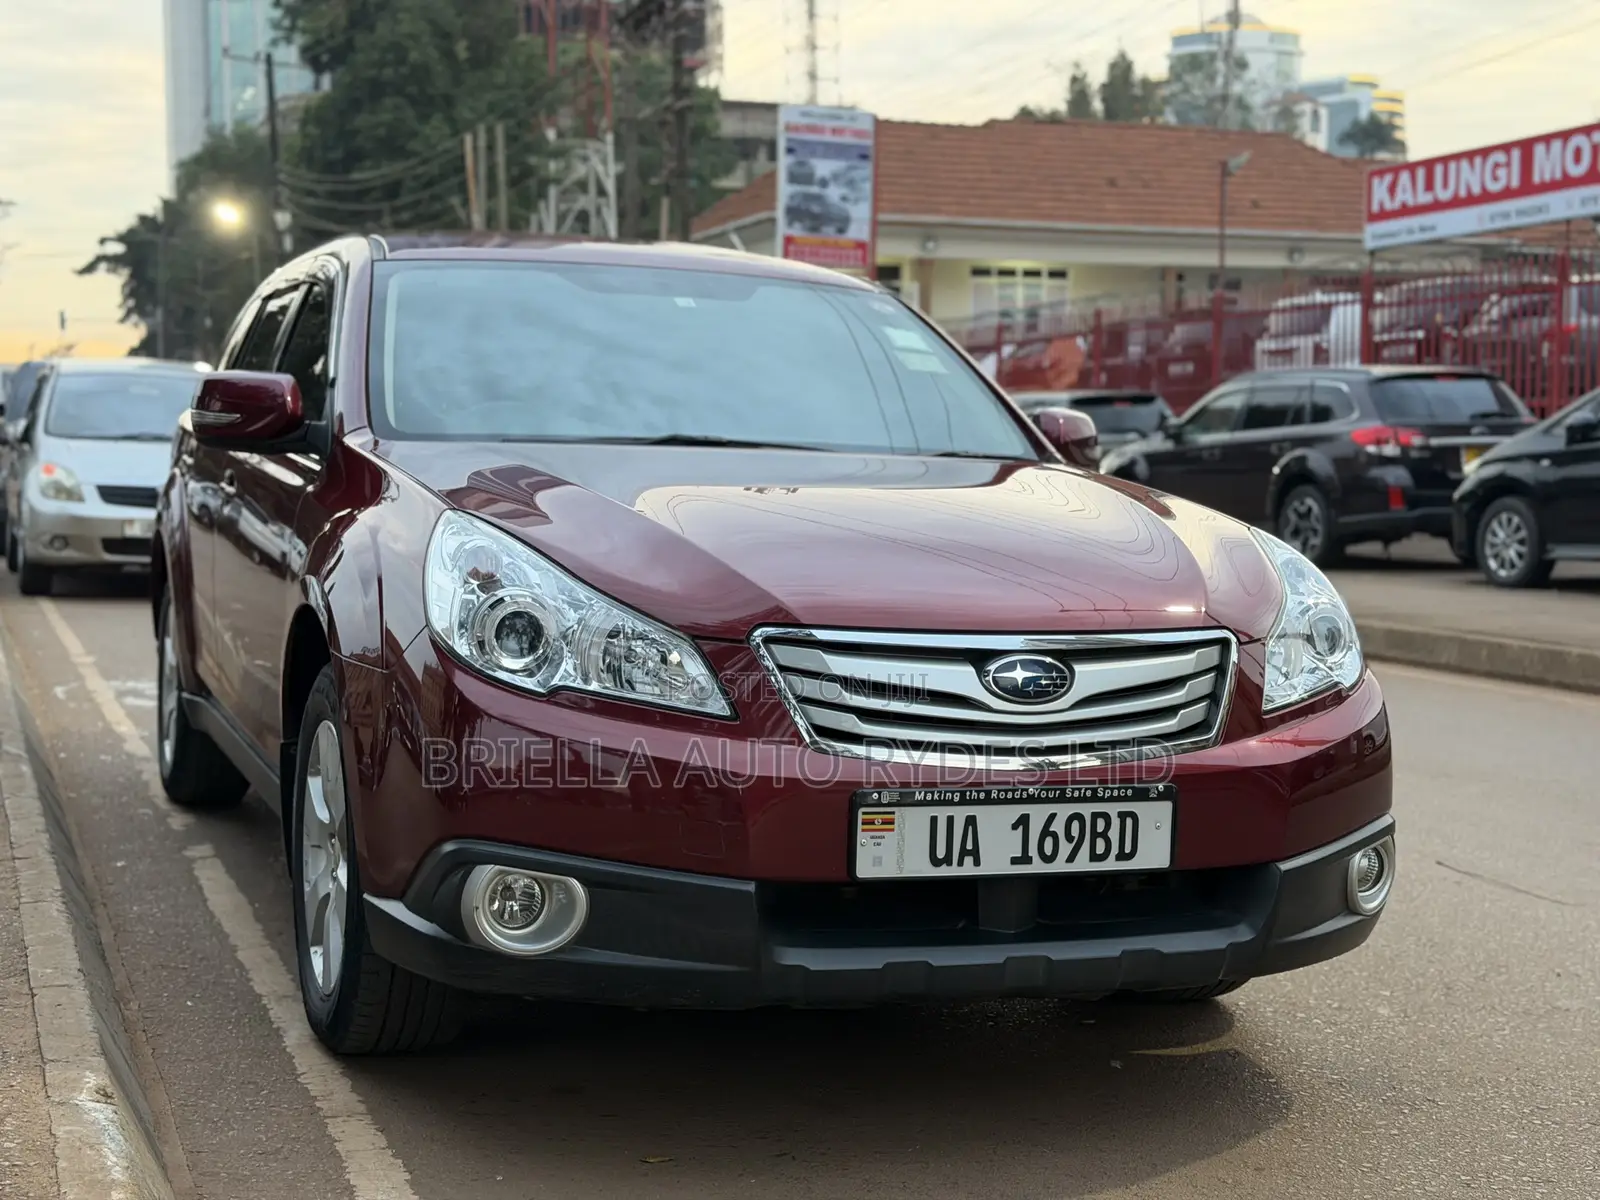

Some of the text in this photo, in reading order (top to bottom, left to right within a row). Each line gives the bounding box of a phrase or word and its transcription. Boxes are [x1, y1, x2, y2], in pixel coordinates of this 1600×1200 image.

[1370, 148, 1522, 214] KALUNGI
[914, 787, 1133, 803] Making the Roads Your Safe Space
[928, 814, 982, 868] UA
[1010, 810, 1140, 866] 169BD
